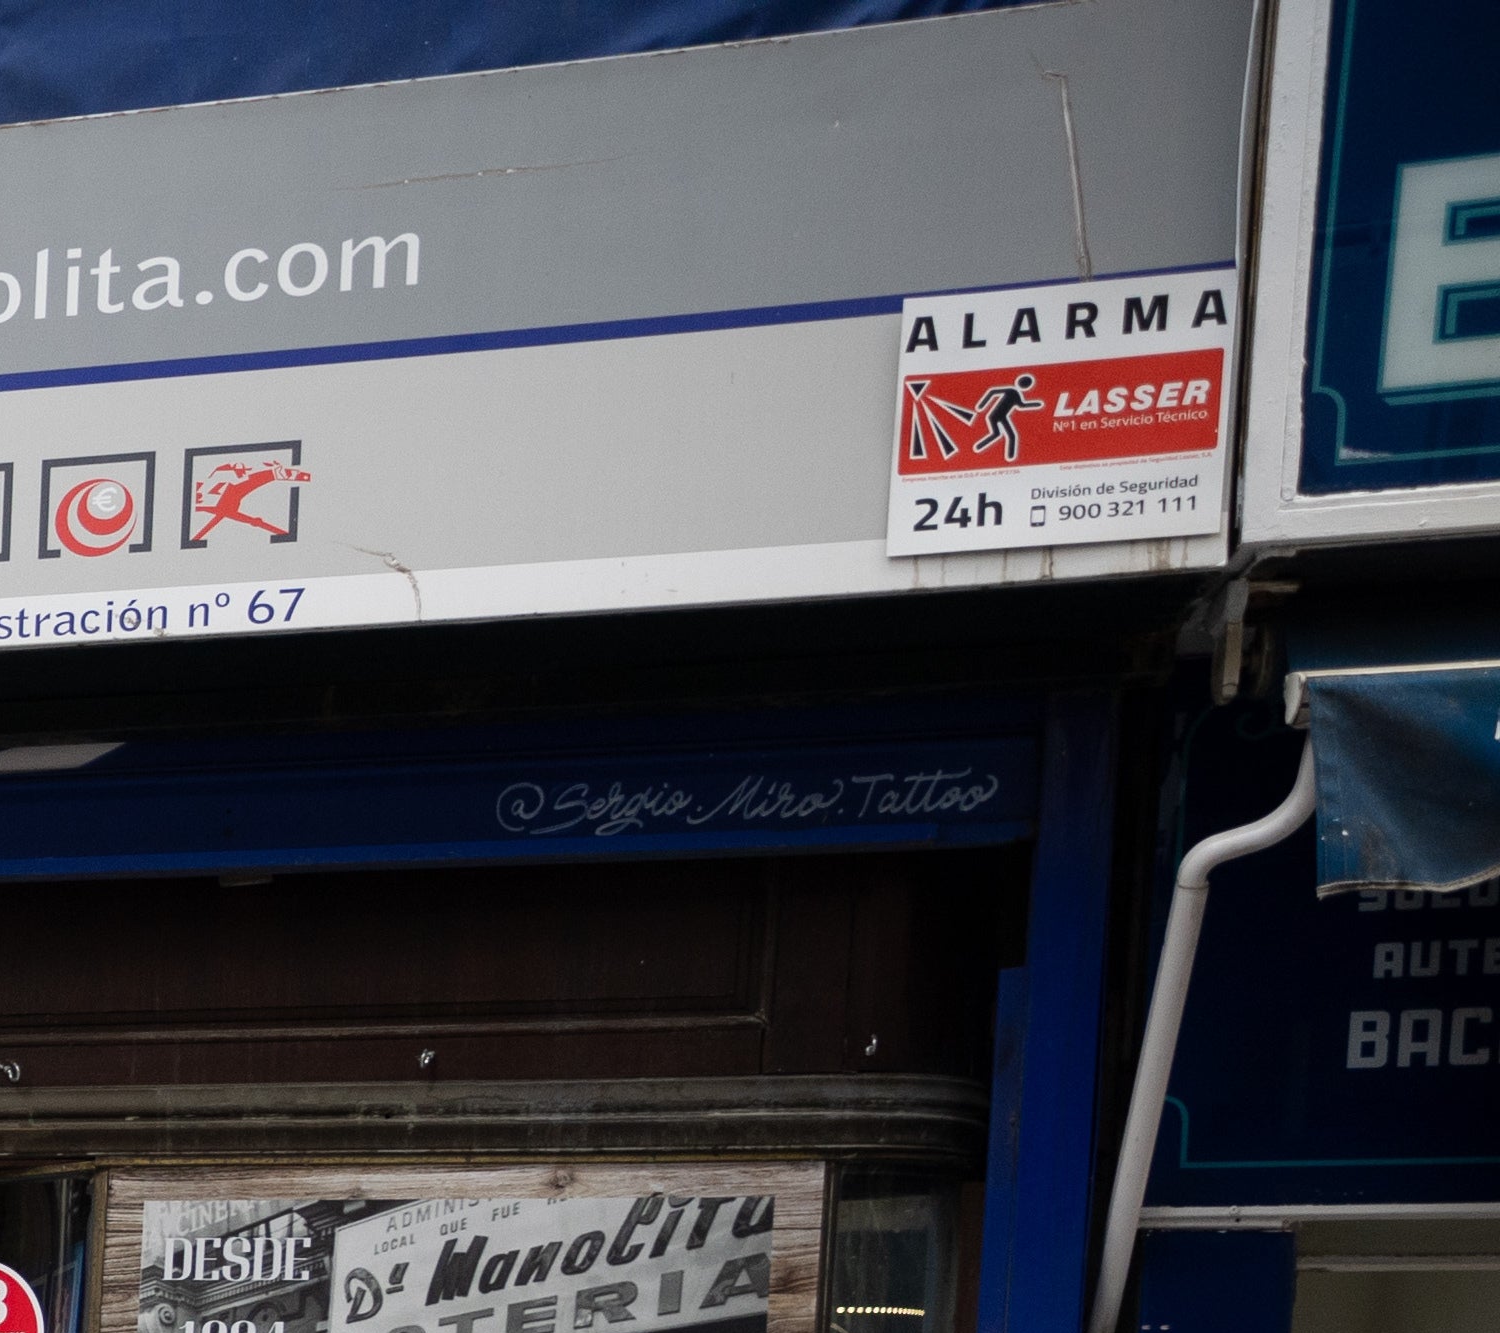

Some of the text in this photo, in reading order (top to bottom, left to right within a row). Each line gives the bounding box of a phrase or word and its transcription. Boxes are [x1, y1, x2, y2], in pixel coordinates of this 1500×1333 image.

[904, 288, 1228, 354] ALARMA
[1052, 378, 1211, 418] LASSER
[1080, 420, 1098, 431] en
[1100, 412, 1154, 430] Servicio
[1155, 408, 1208, 424] Técnico
[1030, 474, 1199, 501] División de Seguridad
[1057, 494, 1198, 521] 900 321 111
[912, 491, 1004, 533] 24h
[187, 592, 232, 629] nº
[245, 587, 307, 624] 67
[1345, 1005, 1500, 1069] BAC
[373, 1201, 521, 1256] LOCAL QUE FUE
[162, 1236, 312, 1282] DESDE
